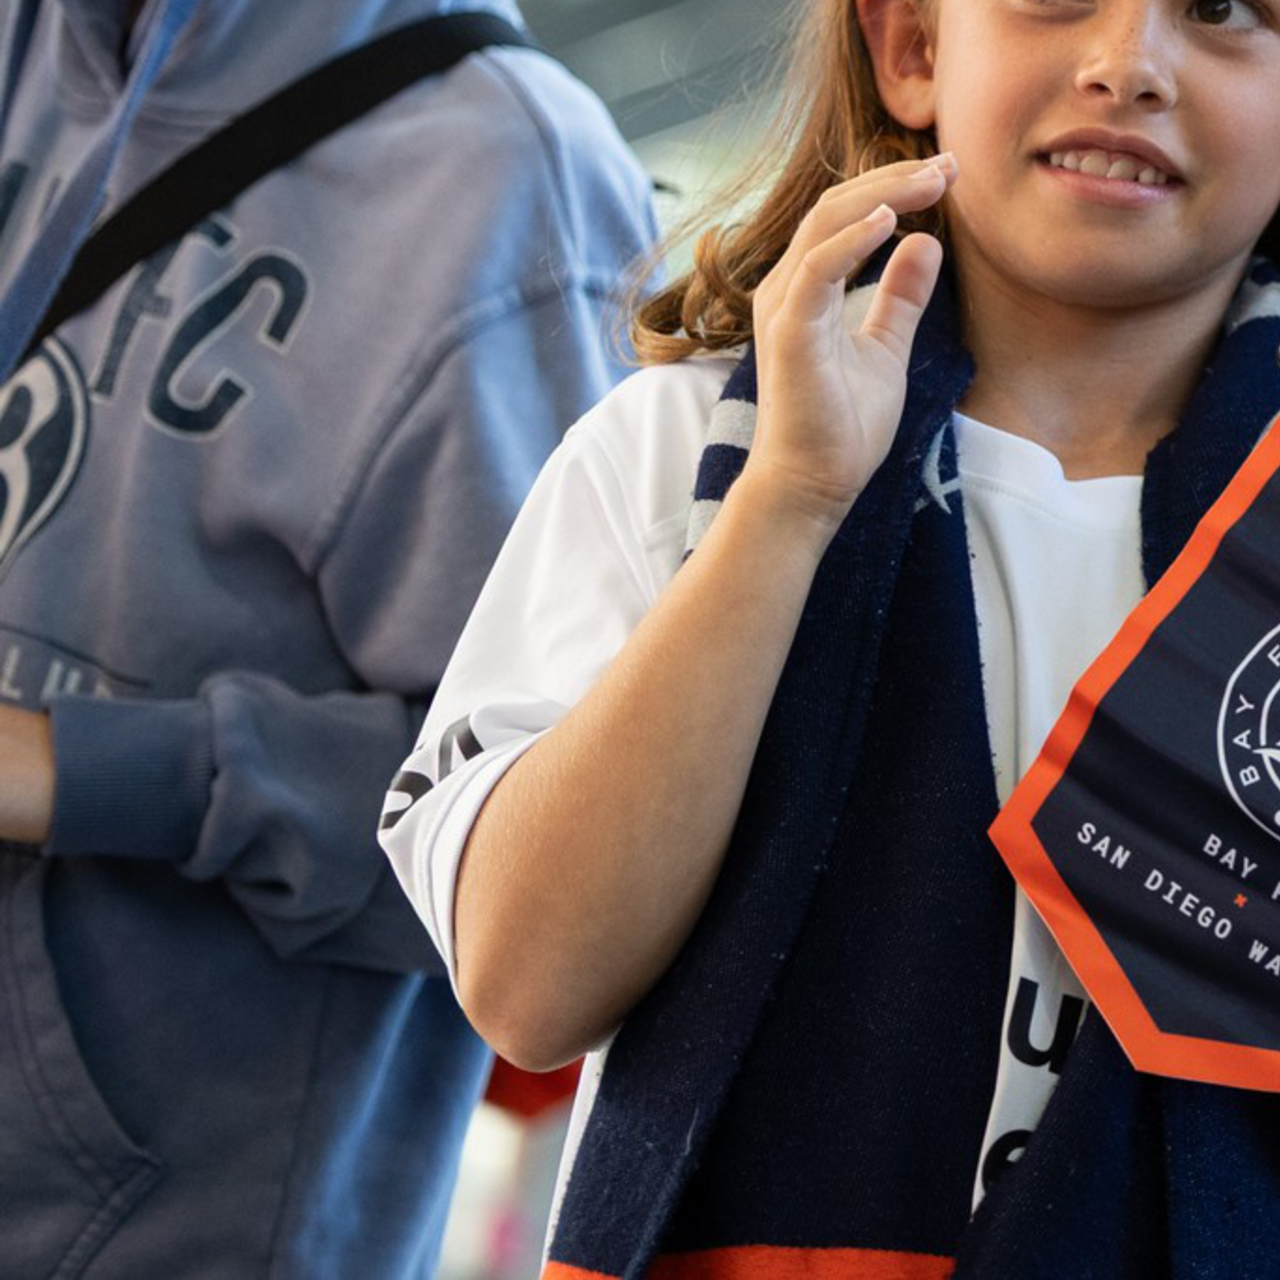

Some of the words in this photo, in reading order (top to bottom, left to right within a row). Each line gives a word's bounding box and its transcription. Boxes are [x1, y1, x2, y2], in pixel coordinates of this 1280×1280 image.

[1232, 694, 1261, 787] BAY
[1076, 821, 1132, 870] SAN
[1143, 868, 1234, 940] DIEGO
[1202, 833, 1258, 880] BAY
